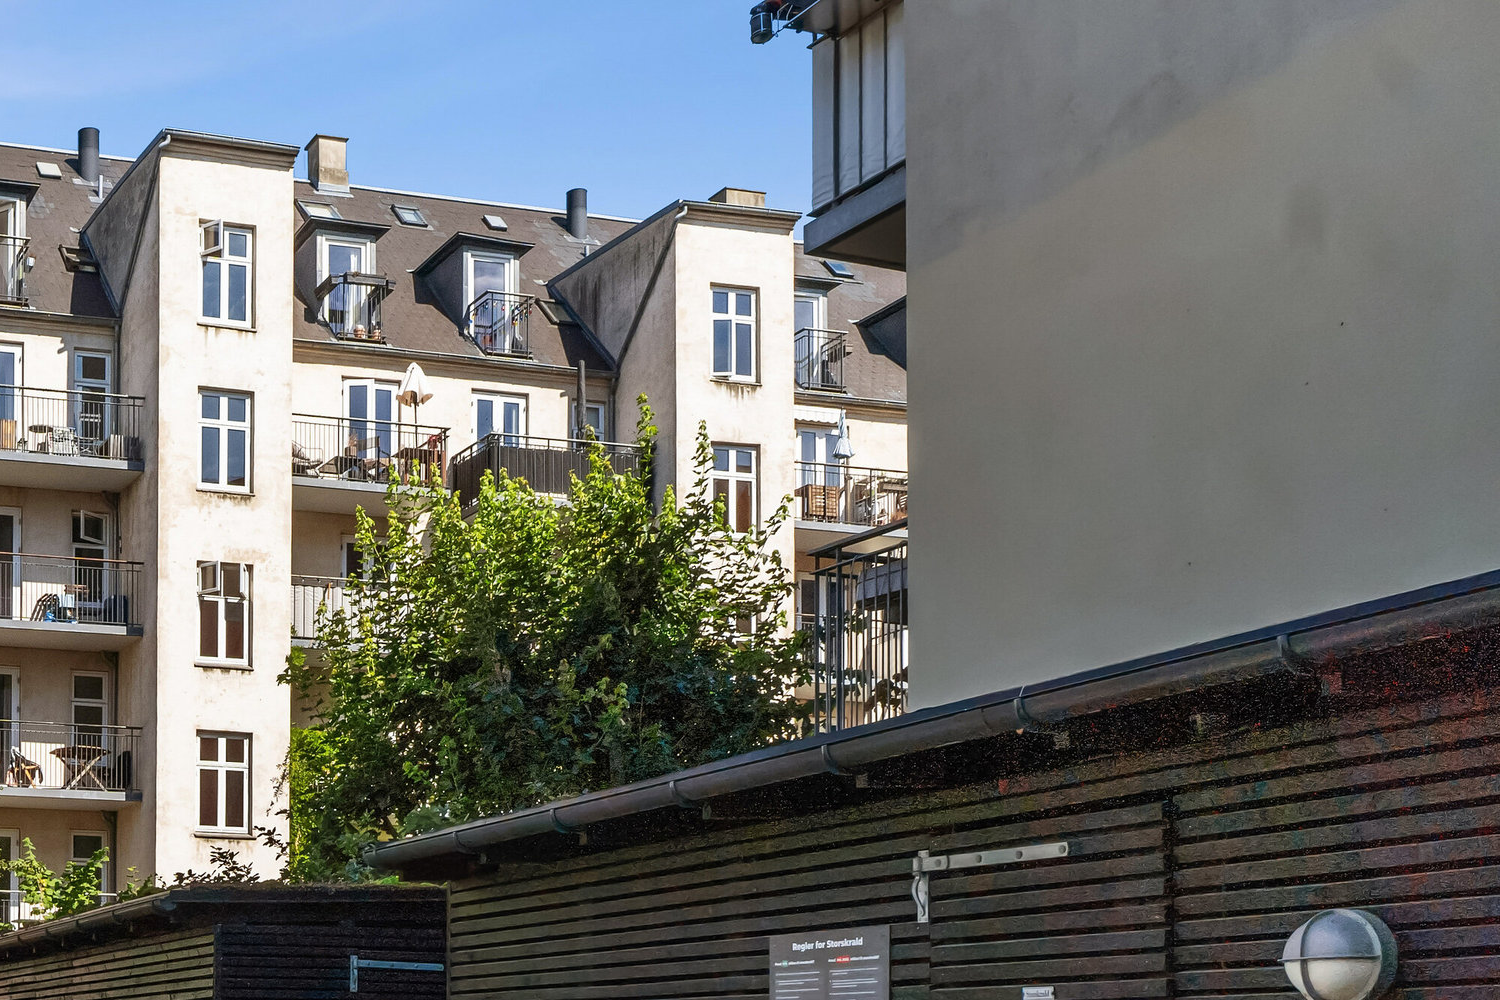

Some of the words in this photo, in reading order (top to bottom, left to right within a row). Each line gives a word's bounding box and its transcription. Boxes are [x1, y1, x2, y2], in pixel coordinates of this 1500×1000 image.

[792, 942, 814, 952] Regler
[815, 940, 826, 949] for
[826, 937, 864, 949] Storskrald
